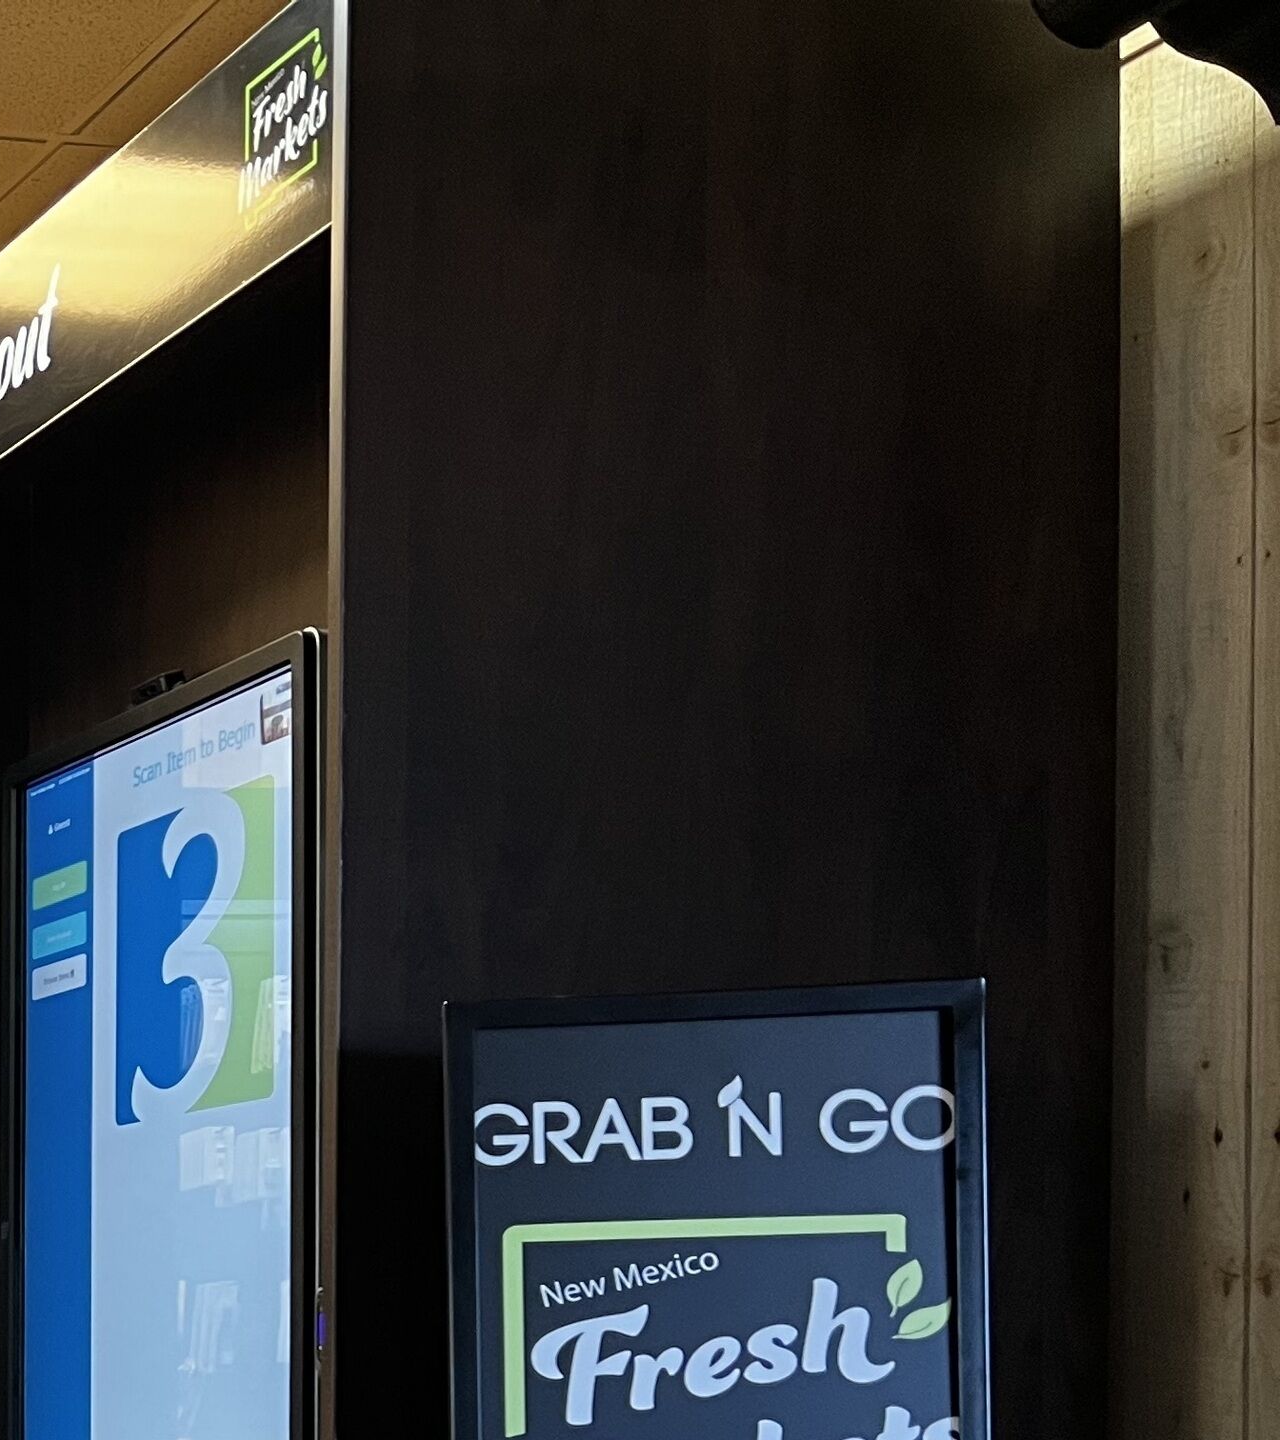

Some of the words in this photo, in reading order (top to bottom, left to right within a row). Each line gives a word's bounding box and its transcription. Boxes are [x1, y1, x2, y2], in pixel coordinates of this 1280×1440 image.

[237, 84, 329, 214] Markets
[252, 64, 307, 153] Fresh
[132, 761, 163, 788] Scan
[166, 747, 197, 774] Item
[200, 736, 215, 759] to
[218, 721, 256, 751] Begin
[473, 1095, 695, 1168] GRAB
[818, 1083, 955, 1154] GO
[539, 1273, 606, 1309] New
[612, 1251, 721, 1293] Mexico
[529, 1276, 896, 1427] Fresh
